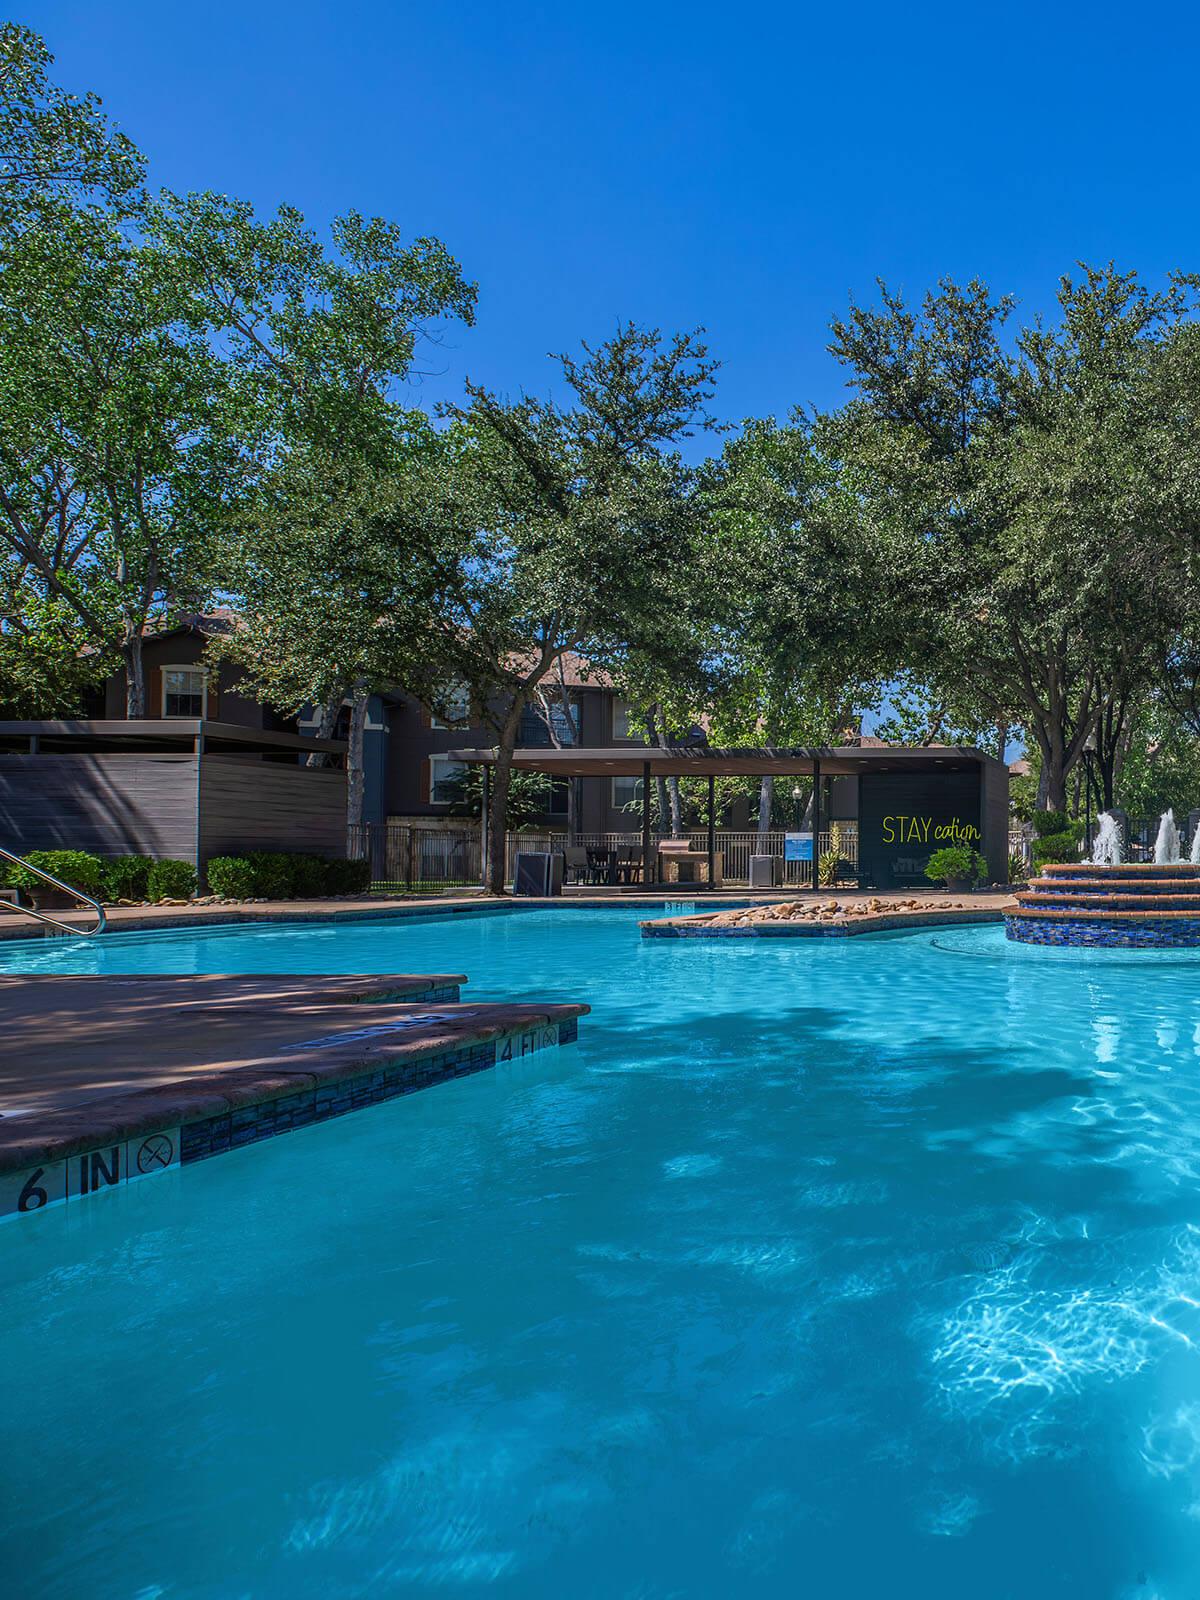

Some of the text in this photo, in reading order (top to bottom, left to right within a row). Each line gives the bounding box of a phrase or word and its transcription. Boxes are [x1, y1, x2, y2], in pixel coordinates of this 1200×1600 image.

[500, 1031, 537, 1061] 4 FT
[18, 1146, 120, 1212] 6 IN
